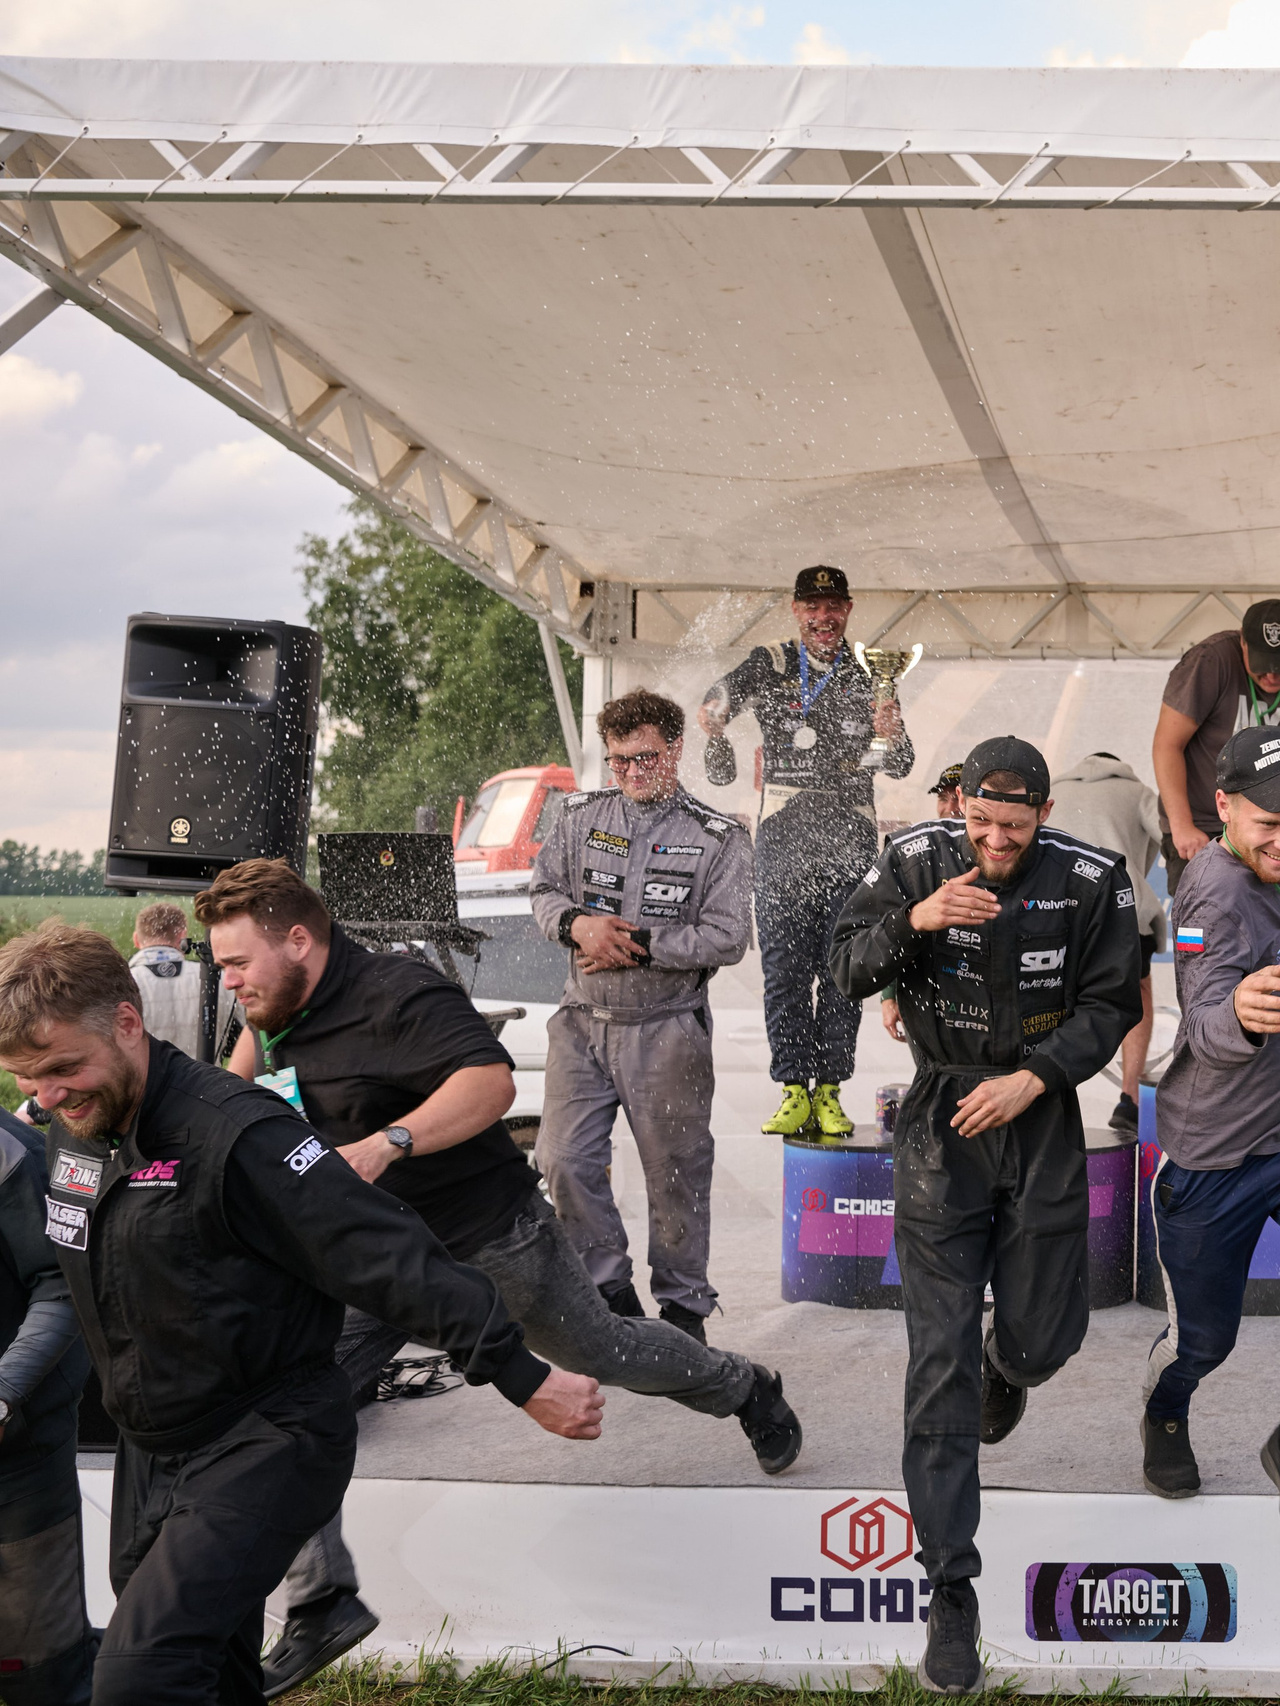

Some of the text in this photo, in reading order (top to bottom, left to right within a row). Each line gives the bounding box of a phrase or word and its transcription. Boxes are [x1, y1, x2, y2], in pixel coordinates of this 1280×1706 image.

[586, 838, 628, 858] MOTORS
[593, 830, 628, 848] OMEGA
[904, 838, 929, 855] OMP
[591, 871, 617, 885] SSP
[1074, 861, 1102, 879] OMP
[948, 927, 981, 944] SSP
[1023, 1020, 1059, 1036] КАРДАН
[289, 1139, 323, 1171] OMP
[834, 1198, 895, 1216] СОЮЗ
[1078, 1578, 1185, 1615] TARGET
[1082, 1618, 1180, 1627] ENERGY DRINK
